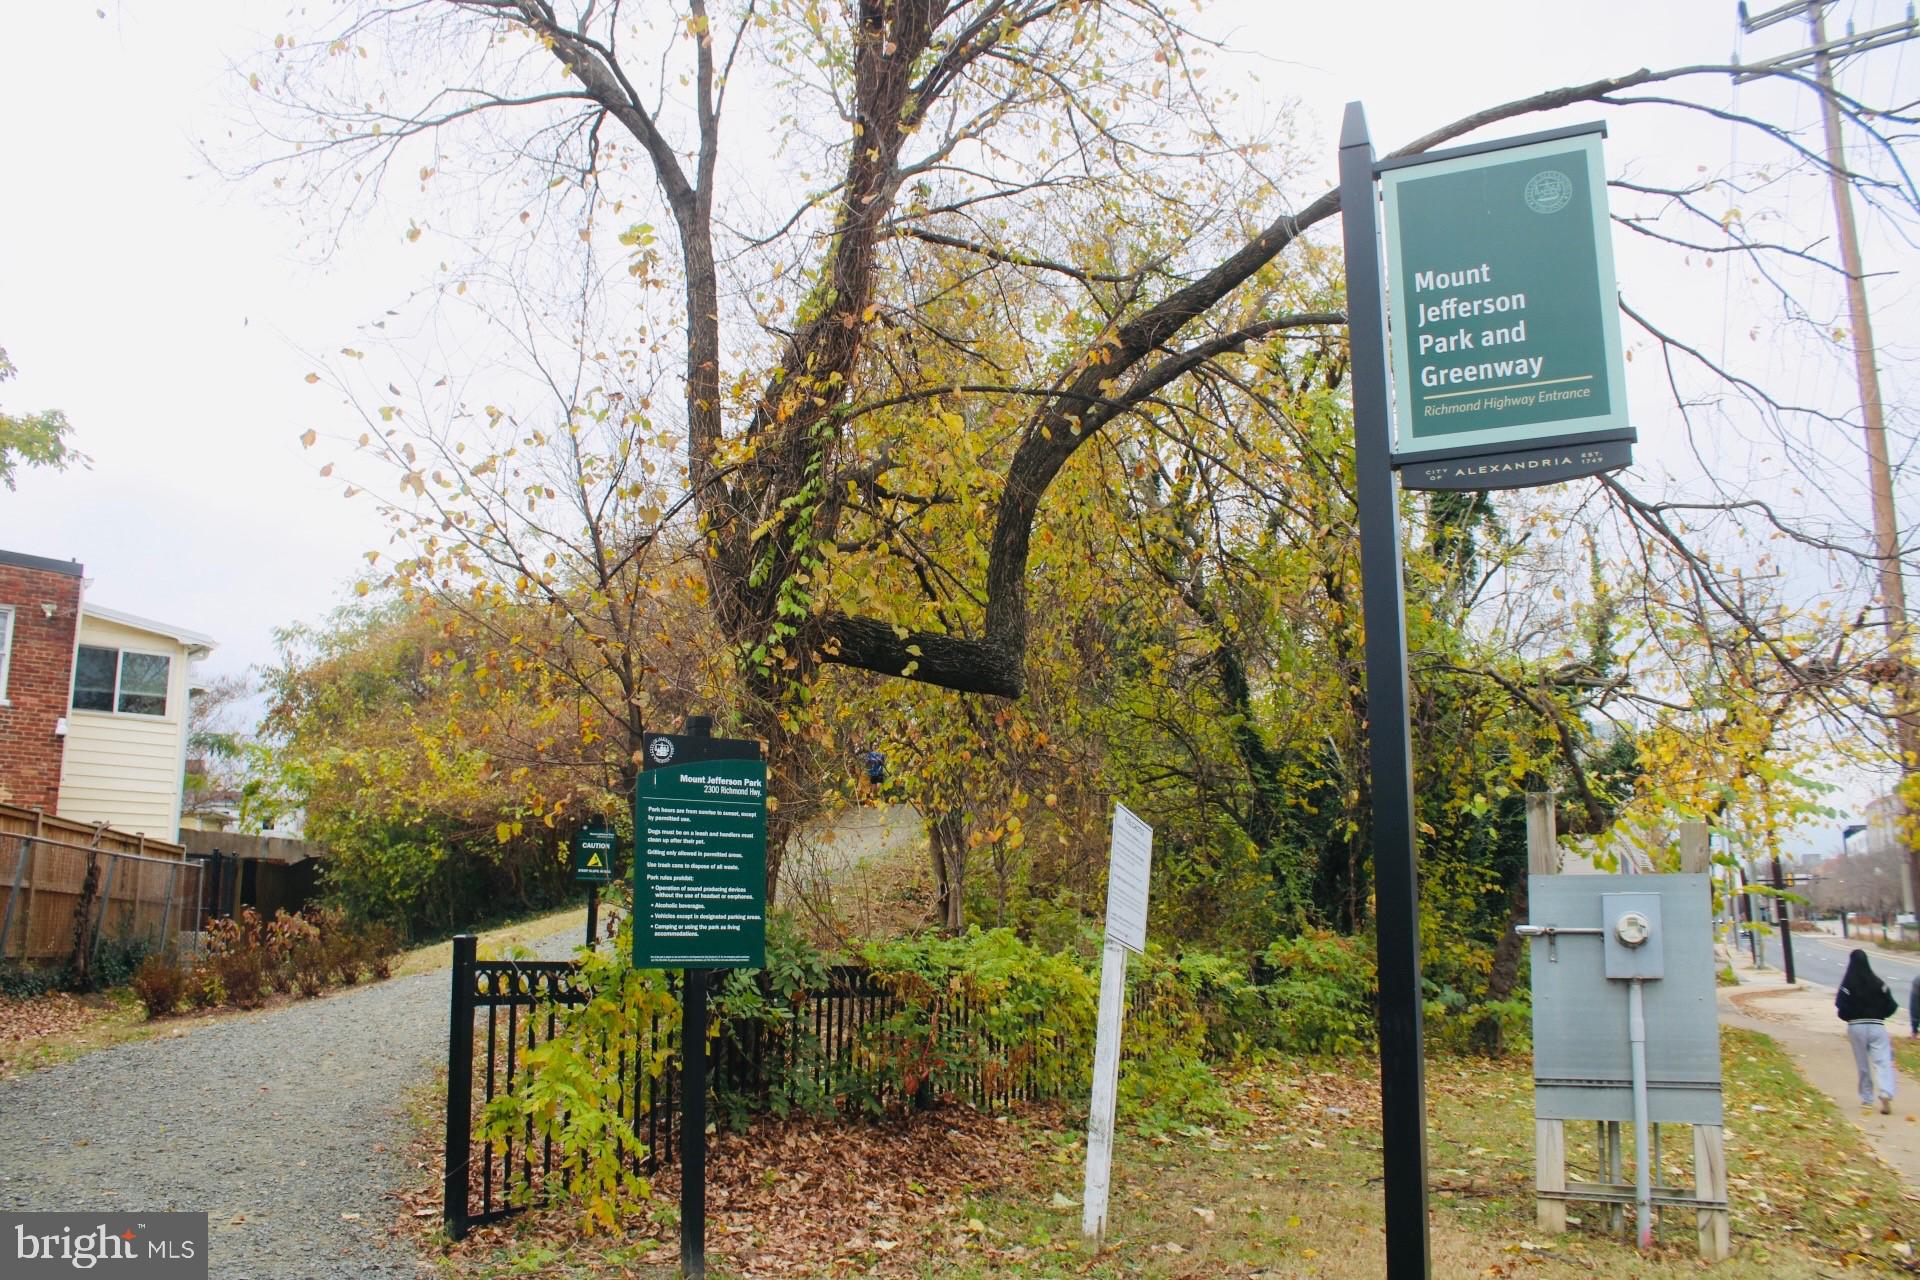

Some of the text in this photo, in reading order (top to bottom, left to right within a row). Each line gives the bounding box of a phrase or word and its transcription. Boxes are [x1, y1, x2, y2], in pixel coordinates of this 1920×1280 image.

[1415, 264, 1491, 292] Mount
[1418, 293, 1525, 327] Jefferson
[1419, 320, 1526, 355] Park and
[1421, 356, 1544, 387] Greenway
[1424, 387, 1590, 416] Richmond Highway Entrance
[1456, 457, 1572, 476] ALEXANDRIA
[680, 774, 762, 787] Mount Jefferson Park
[721, 786, 748, 795] Richmond
[750, 788, 762, 797] Hwy.
